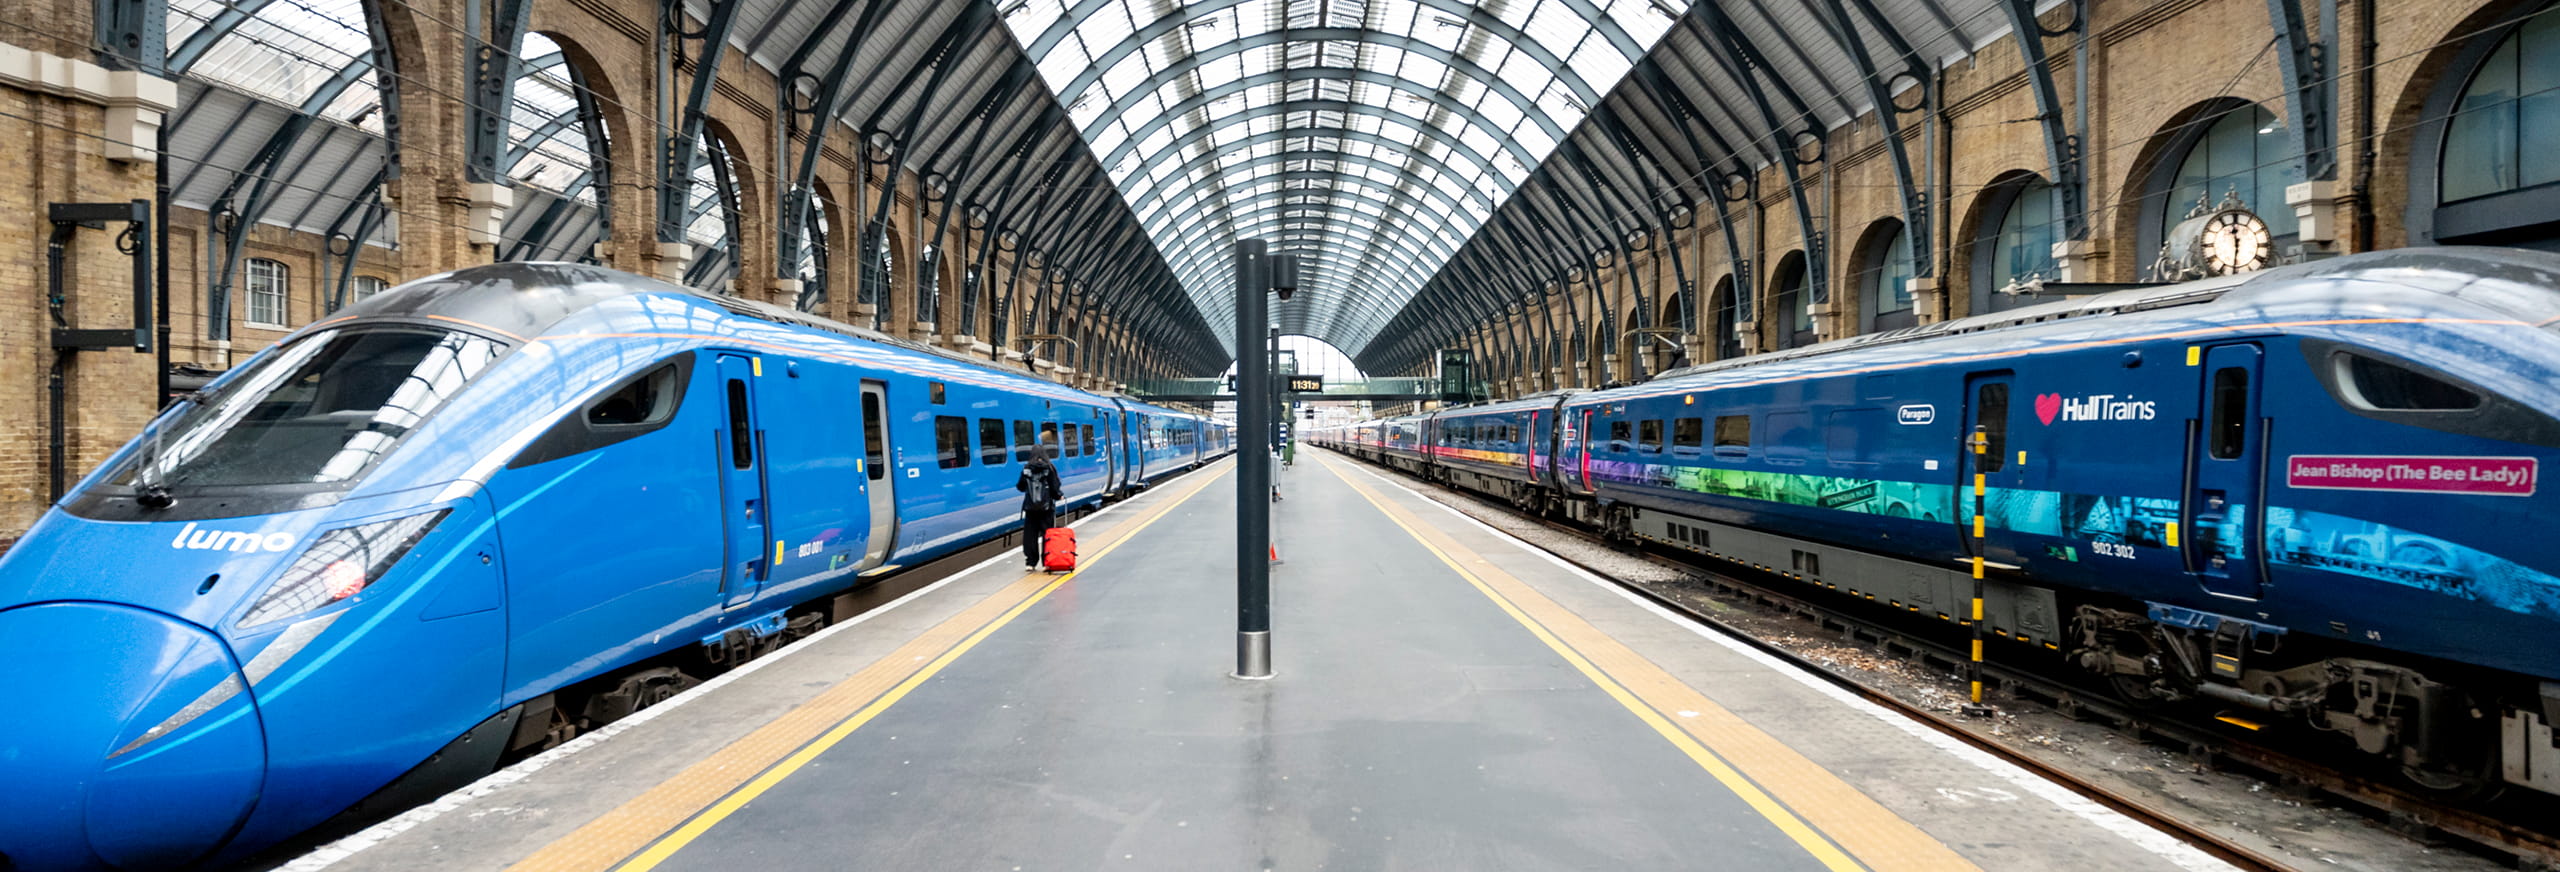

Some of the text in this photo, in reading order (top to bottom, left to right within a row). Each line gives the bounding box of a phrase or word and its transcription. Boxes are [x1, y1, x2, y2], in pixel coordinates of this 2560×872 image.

[1902, 409, 1930, 421] Paragon
[2293, 463, 2529, 487] Jean Bishop (The Bee Lady)
[171, 522, 296, 553] lumo
[2091, 541, 2136, 560] 902 302
